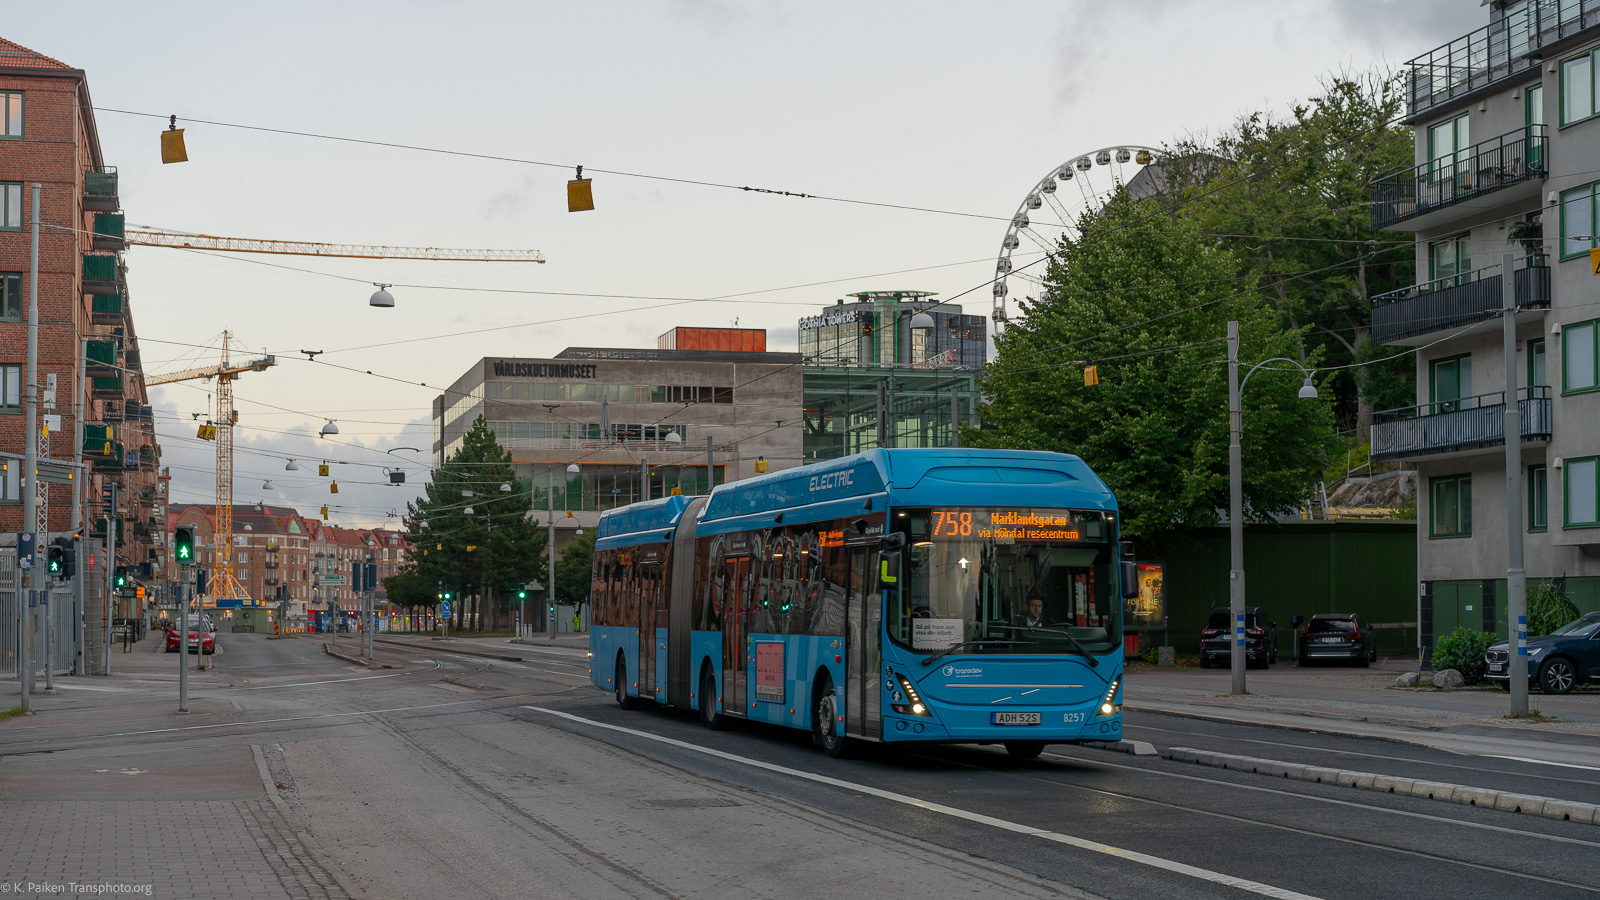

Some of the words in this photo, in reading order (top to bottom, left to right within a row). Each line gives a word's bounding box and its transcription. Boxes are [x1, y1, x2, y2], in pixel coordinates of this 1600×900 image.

[799, 316, 827, 330] GOTHIA
[827, 312, 856, 326] TOWERS
[493, 360, 597, 378] VÄRLDSKULTURMUSEET
[809, 469, 854, 491] ELECTRIC
[932, 511, 972, 536] 758
[991, 512, 1066, 528] Marklandsgatan
[977, 528, 991, 538] via
[994, 527, 1025, 539] Mölndal
[1026, 530, 1079, 540] resecentrum
[998, 714, 1017, 723] ADH
[1019, 714, 1037, 723] 52S
[1063, 713, 1085, 723] 8257
